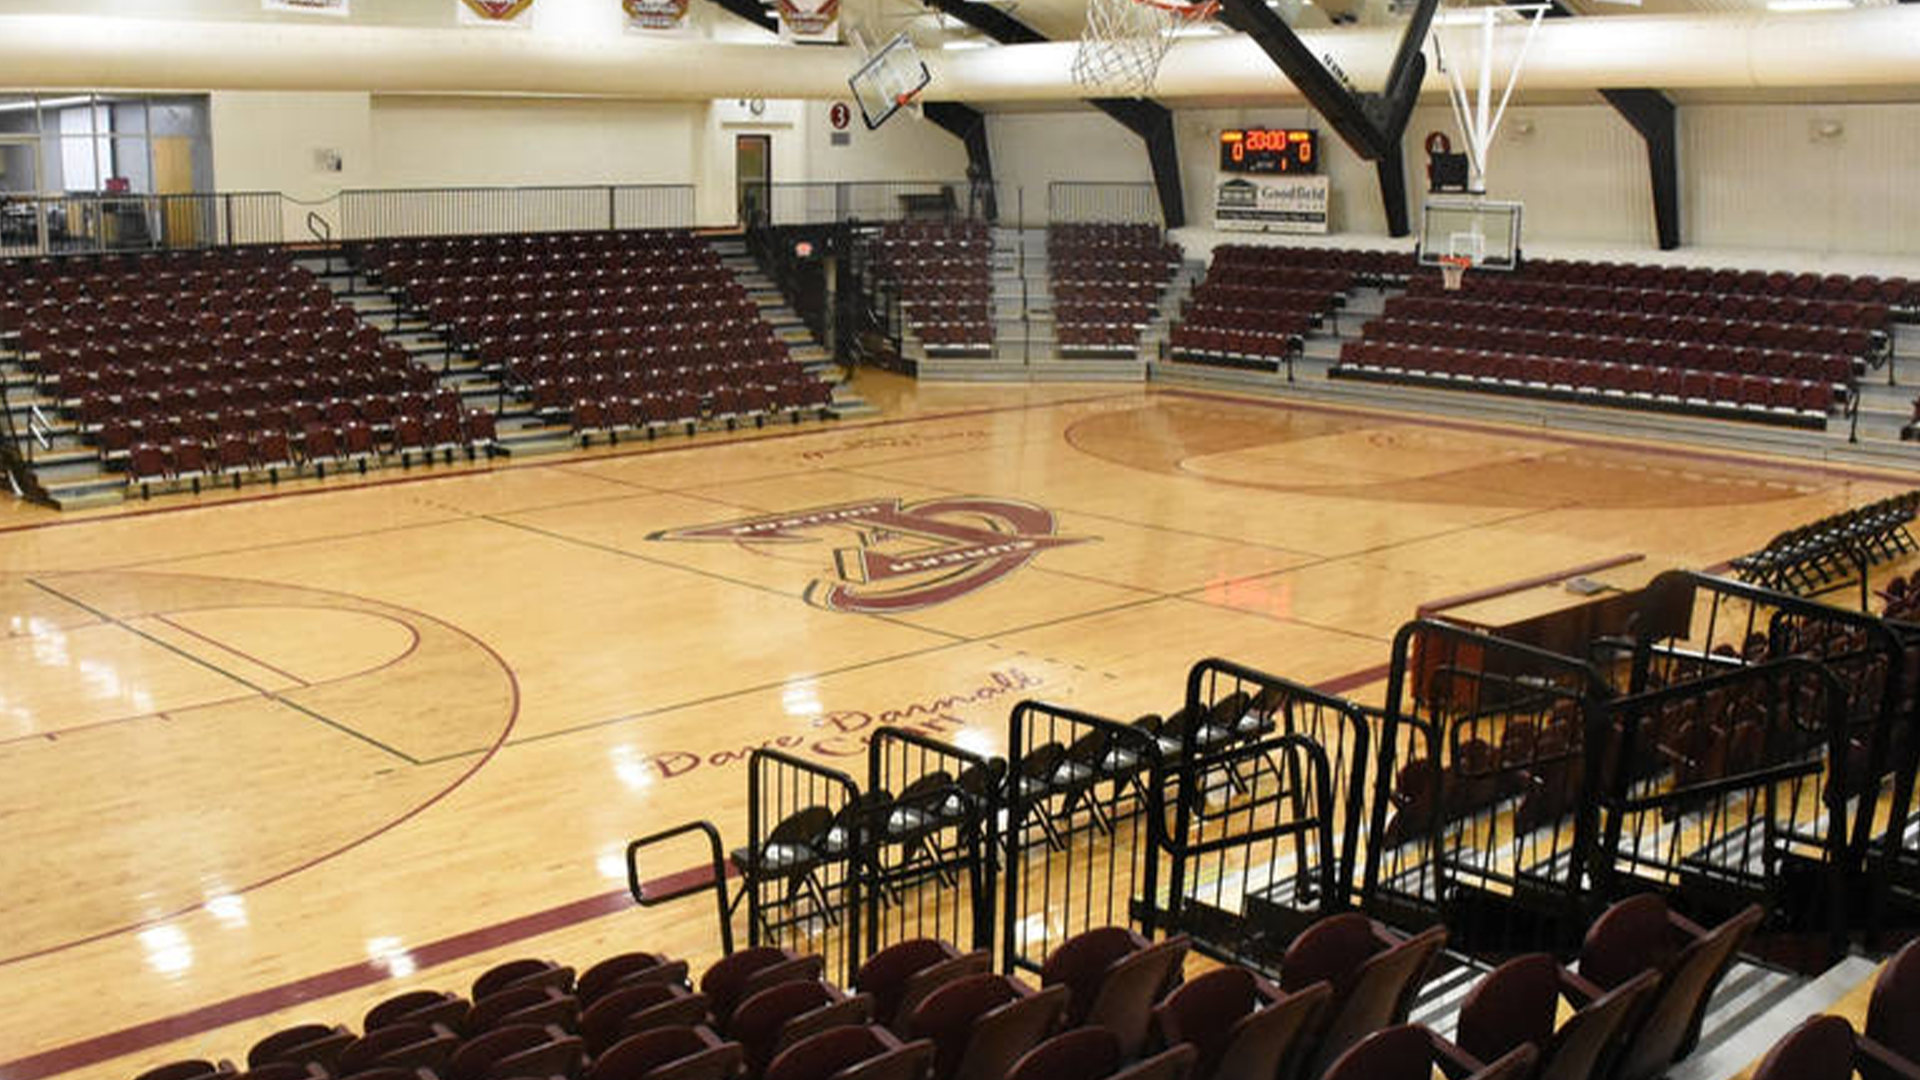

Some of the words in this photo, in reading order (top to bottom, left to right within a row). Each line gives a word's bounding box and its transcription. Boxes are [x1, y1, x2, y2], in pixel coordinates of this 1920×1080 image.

[835, 104, 846, 128] 3
[1246, 130, 1286, 151] 20:00
[1231, 142, 1244, 162] 0
[1299, 142, 1312, 163] 0
[1281, 157, 1287, 171] 1
[1260, 184, 1326, 201] Goodfield
[889, 540, 1036, 573] EUREKA
[650, 735, 804, 779] Dave
[812, 668, 1044, 733] Darnall
